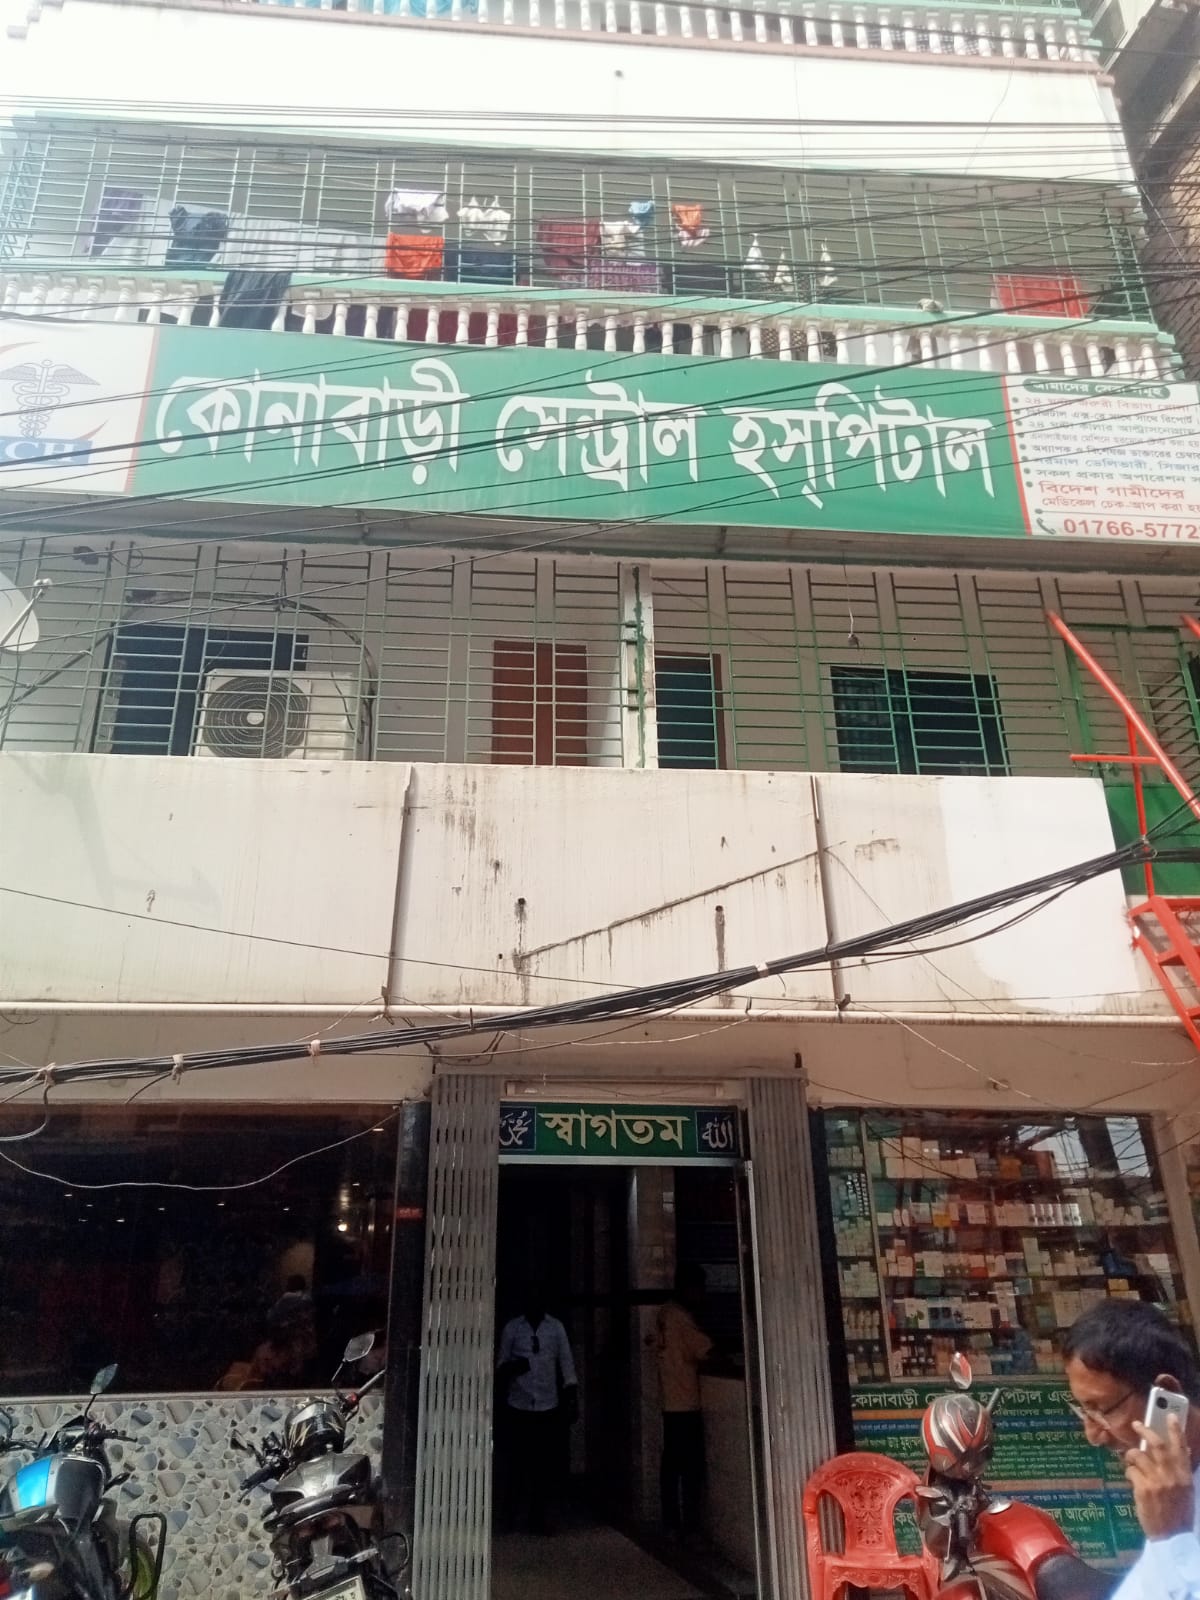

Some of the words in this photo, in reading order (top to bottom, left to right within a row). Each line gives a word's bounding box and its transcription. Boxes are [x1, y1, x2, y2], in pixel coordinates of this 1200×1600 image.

[155, 358, 472, 485] কোনাবাড়ী
[496, 370, 708, 492] সেন্ট্রাল
[0, 439, 76, 464] CH
[1039, 480, 1098, 496] বিদেশ
[1107, 484, 1185, 500] গামীদের
[1064, 519, 1200, 540] 01766-5772
[538, 1109, 690, 1150] স্বাগতম
